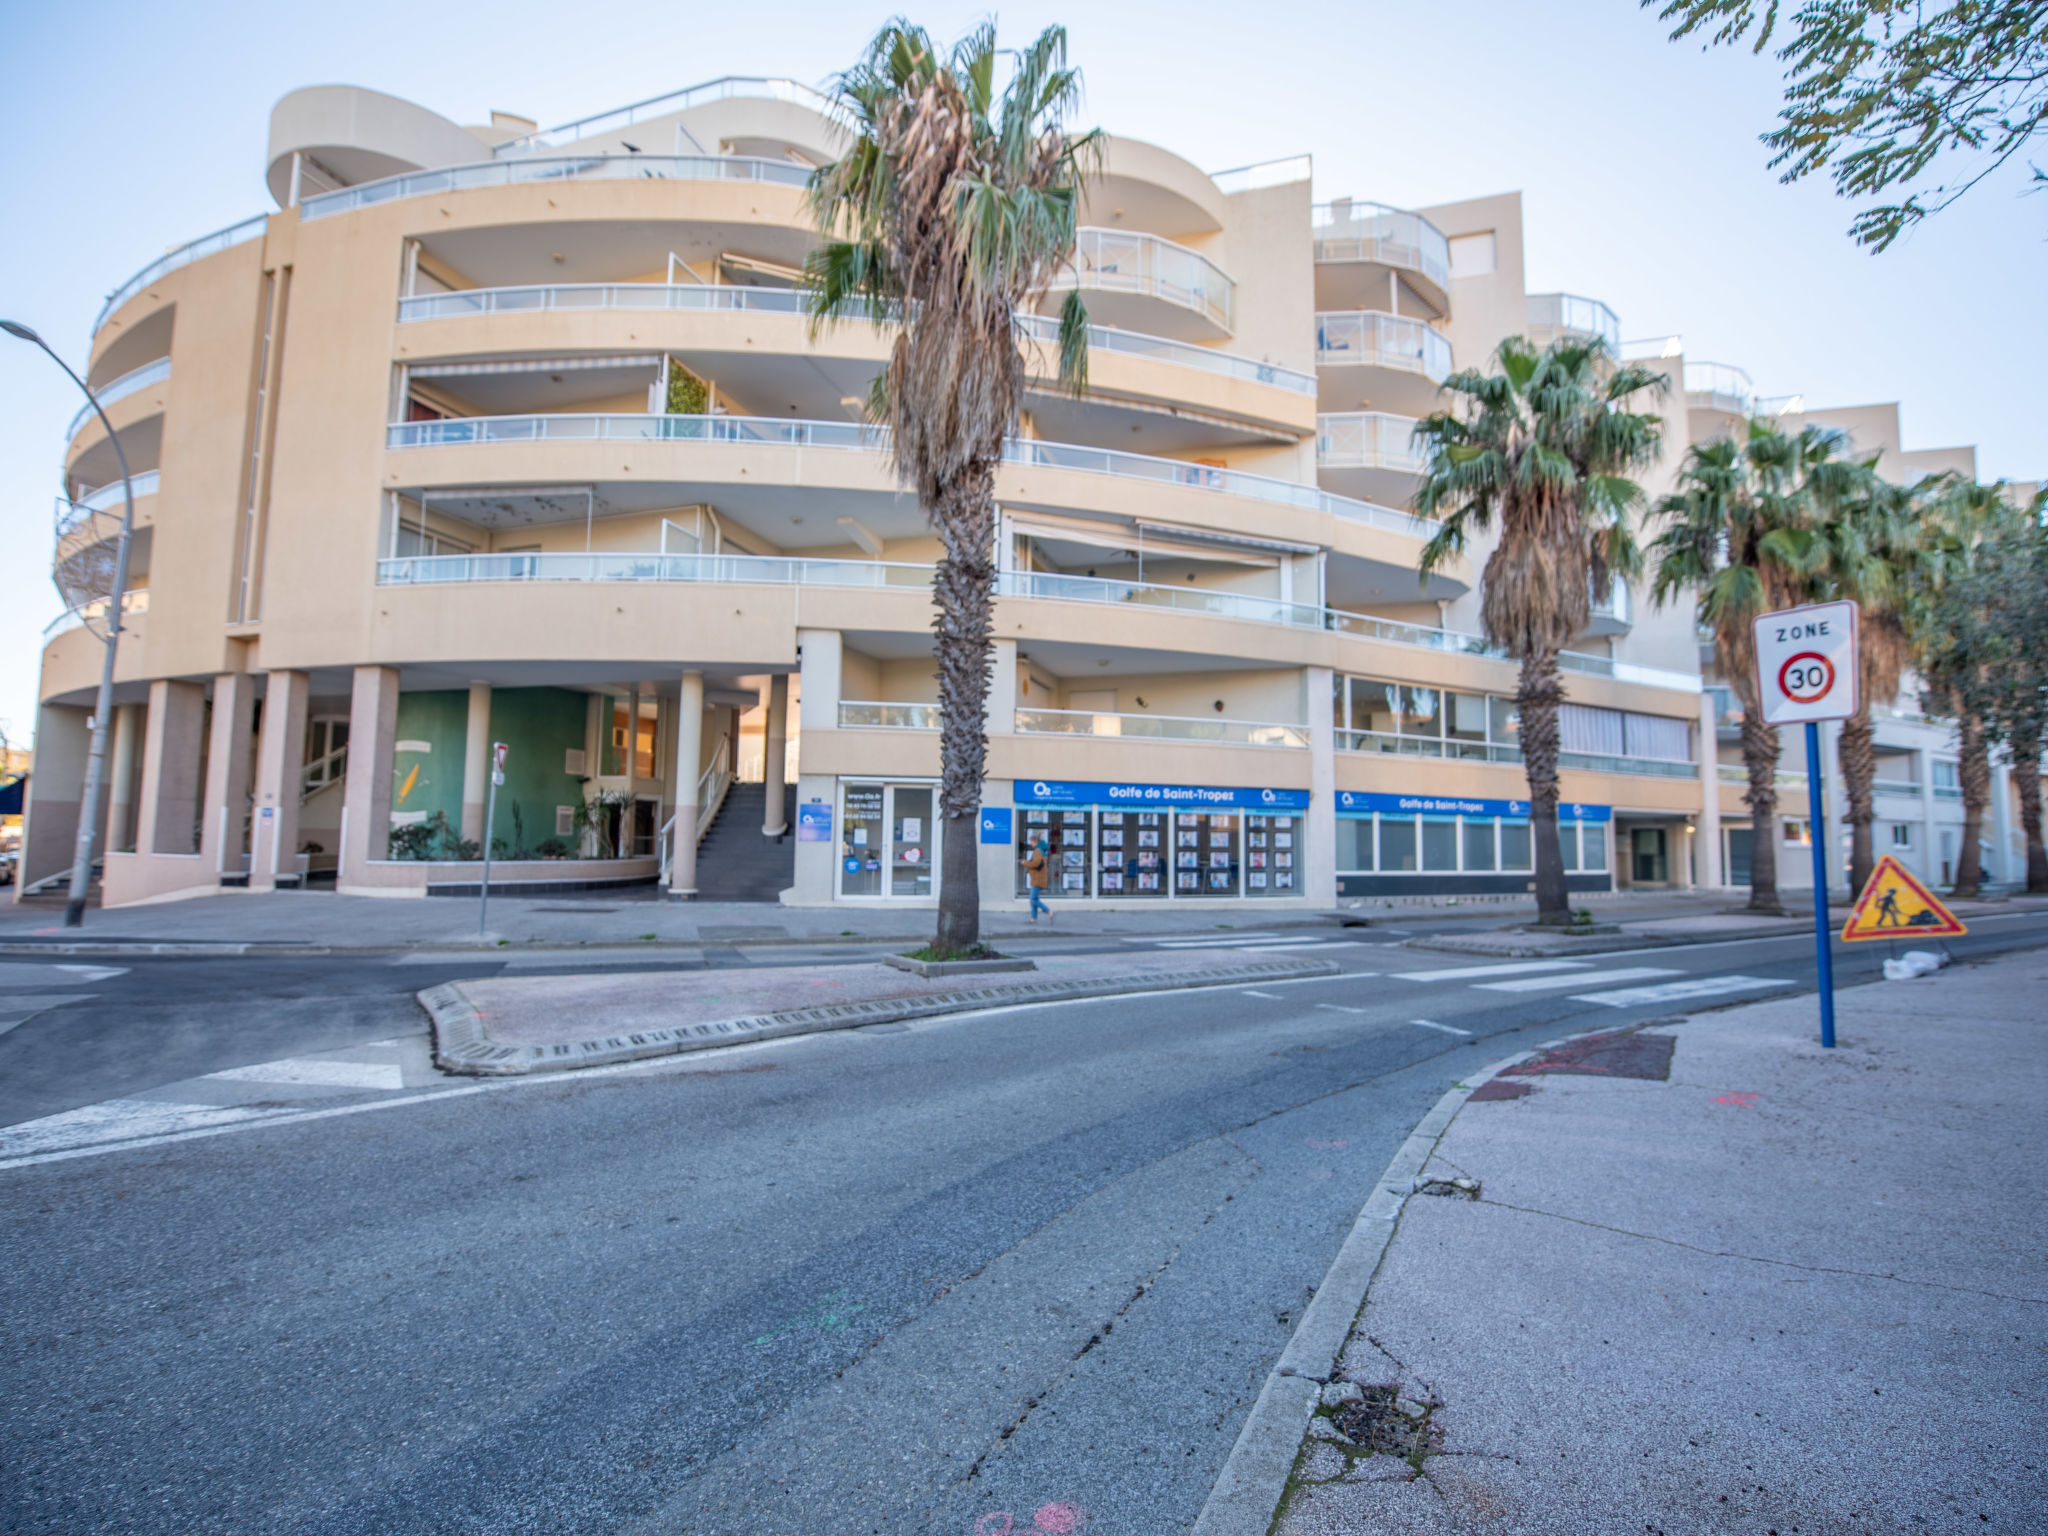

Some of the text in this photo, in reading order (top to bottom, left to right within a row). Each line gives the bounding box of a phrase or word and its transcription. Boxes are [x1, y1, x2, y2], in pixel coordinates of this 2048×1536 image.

[1776, 621, 1831, 642] ZONE
[1790, 666, 1823, 689] 30
[1109, 786, 1234, 802] Golfe de Saint-Tropez
